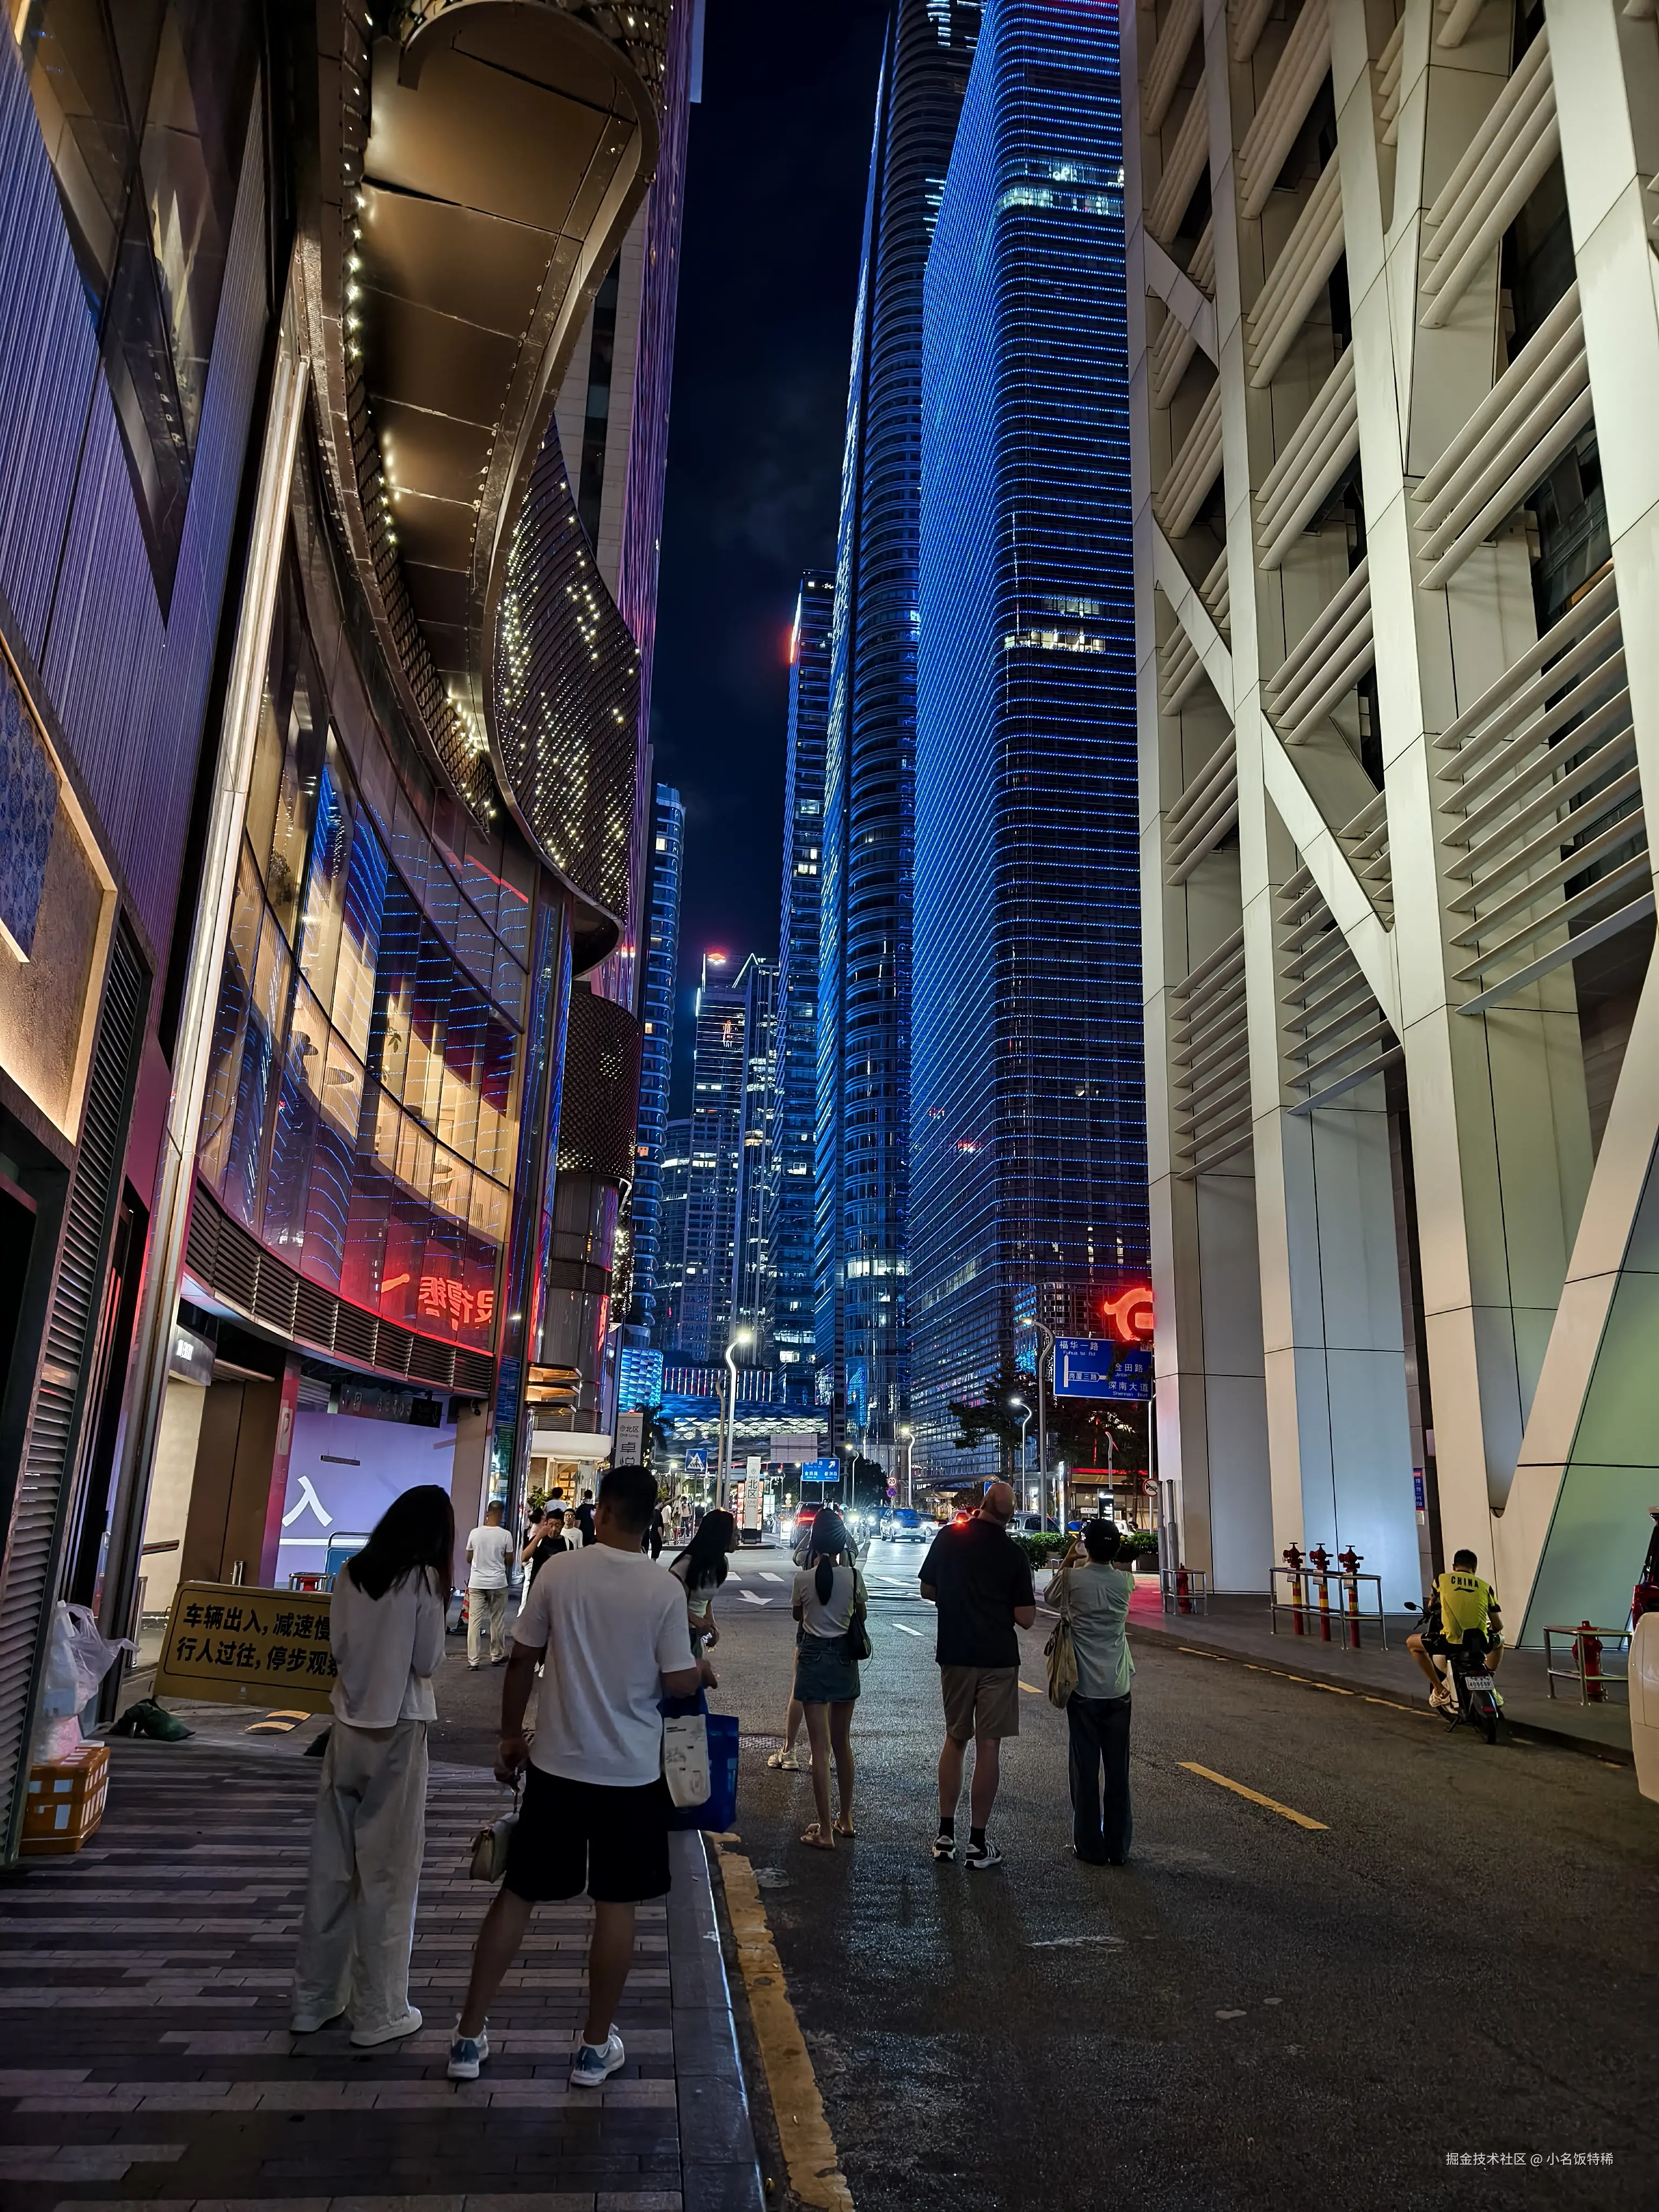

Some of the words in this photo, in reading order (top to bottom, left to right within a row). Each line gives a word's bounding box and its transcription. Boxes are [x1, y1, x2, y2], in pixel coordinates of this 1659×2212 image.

[1059, 1340, 1098, 1351] 福华一路
[1115, 1363, 1143, 1373] 金田路
[1069, 1372, 1097, 1380] 岗厦三路
[1108, 1381, 1149, 1392] 深南大道
[748, 1479, 758, 1499] 北区
[282, 1475, 333, 1528] 入
[1451, 1576, 1479, 1588] CHINA
